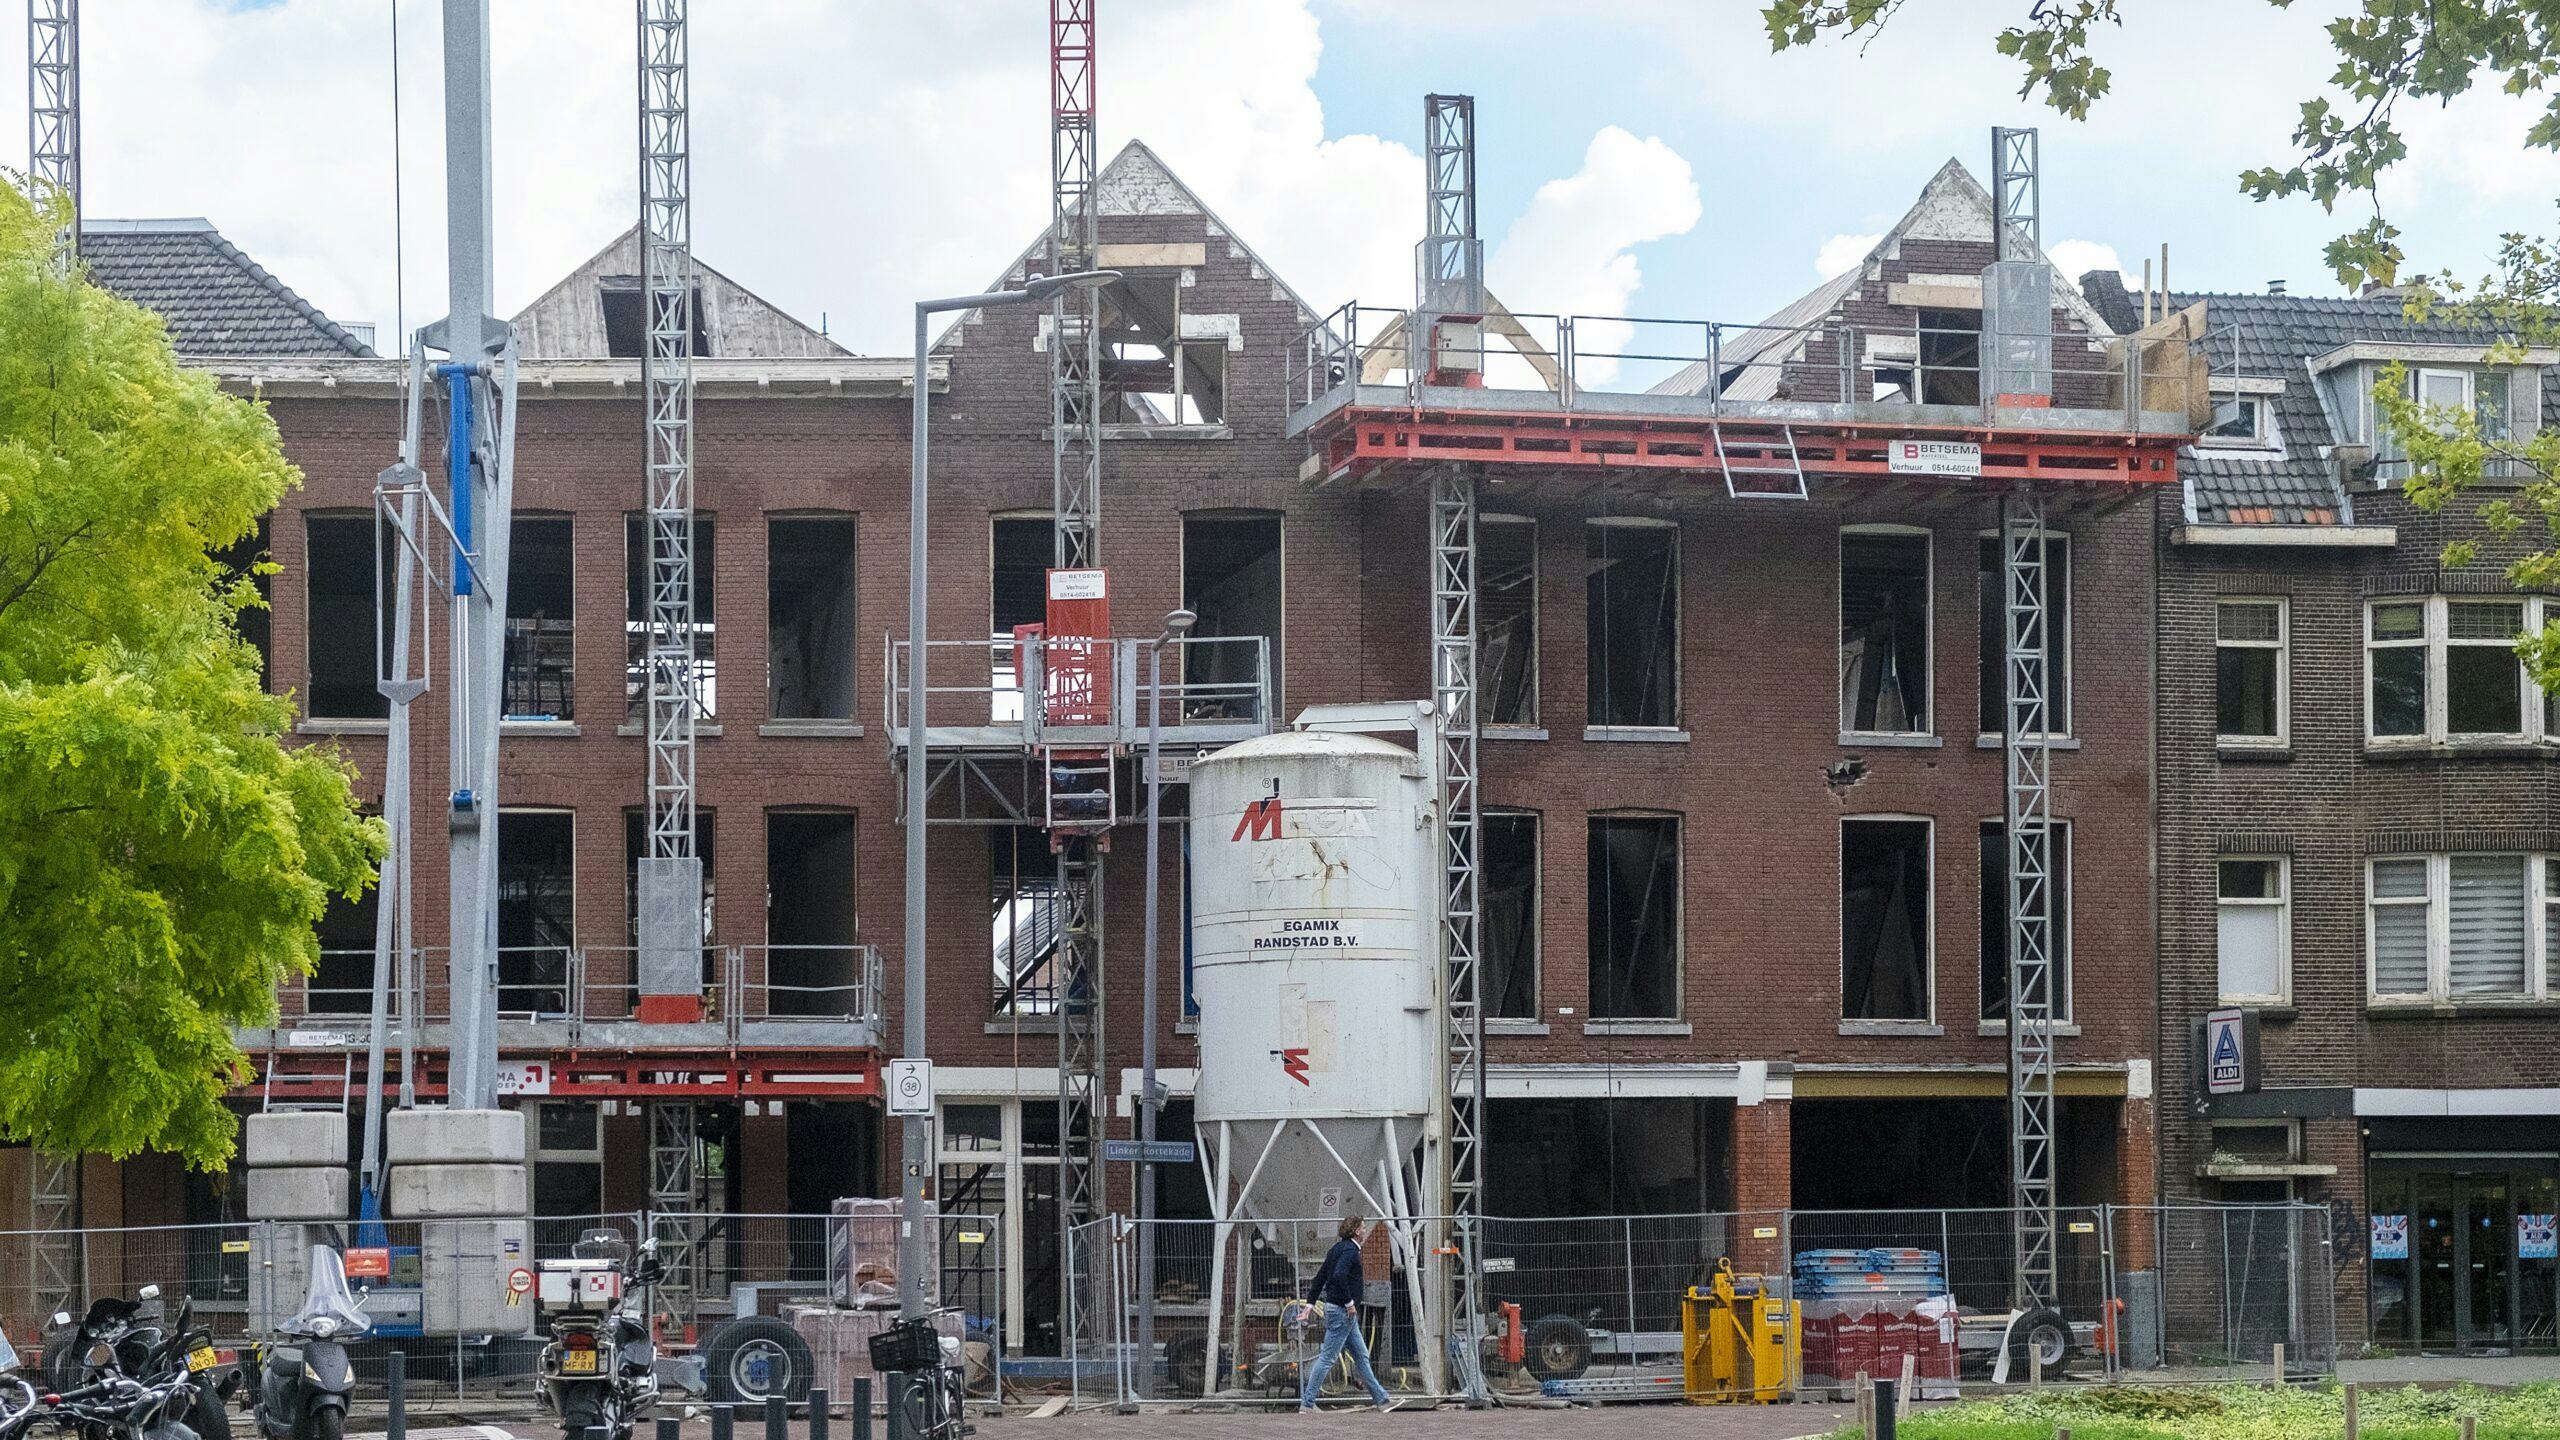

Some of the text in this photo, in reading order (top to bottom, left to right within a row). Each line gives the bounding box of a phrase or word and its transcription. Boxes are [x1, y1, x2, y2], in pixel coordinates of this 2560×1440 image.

[1921, 444, 1979, 455] BETSEMA
[1891, 463, 1980, 473] Verhuur 0514-602418
[1283, 920, 1340, 932] EGAMIX
[1254, 936, 1359, 949] RANDSTAD B.V.
[2216, 1067, 2238, 1079] ALDI
[904, 1082, 918, 1092] 38
[1109, 1145, 1191, 1156] Linker Rottekade
[193, 1350, 207, 1360] MS
[574, 1351, 588, 1361] 85
